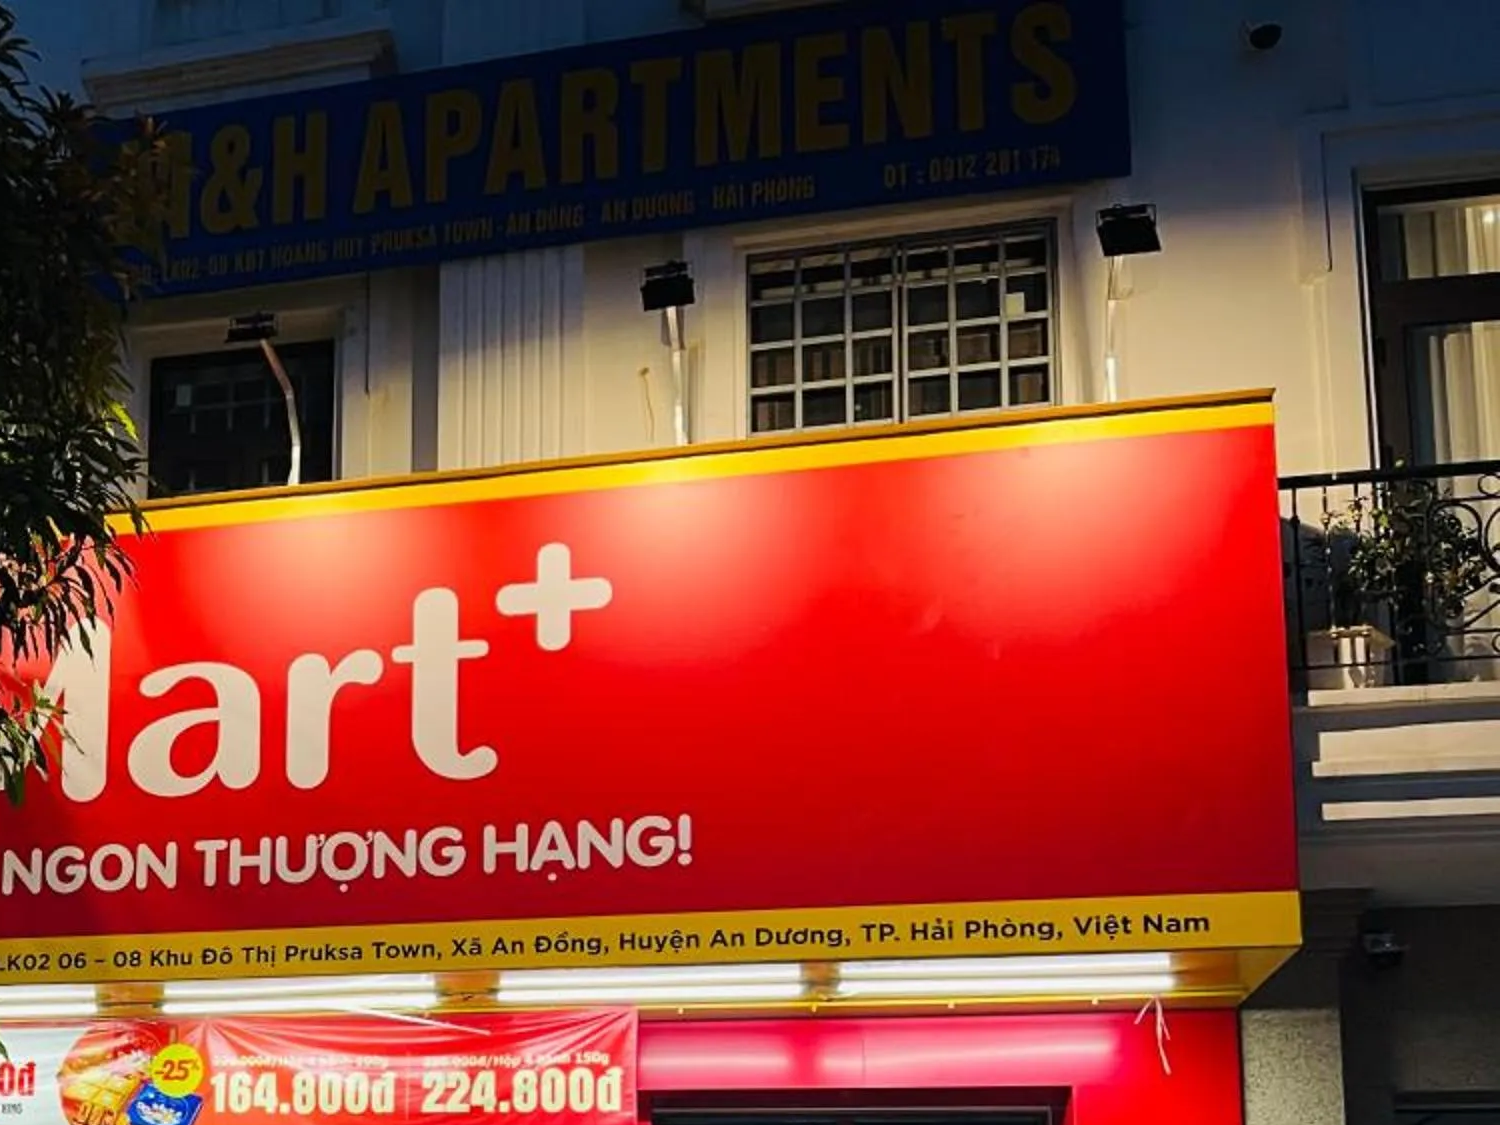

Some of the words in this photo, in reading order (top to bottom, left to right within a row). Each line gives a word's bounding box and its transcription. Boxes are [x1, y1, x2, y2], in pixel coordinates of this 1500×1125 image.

[353, 2, 1079, 214] APARTMENTS
[1, 841, 179, 896] NGON
[195, 826, 466, 893] THƯỢNG
[483, 813, 693, 882] HẠNG!
[57, 951, 87, 970] 06
[113, 950, 141, 969] 08
[150, 947, 194, 967] Khu
[201, 944, 234, 966] Đô
[241, 945, 276, 968] Thị
[285, 941, 363, 963] Pruksa
[372, 939, 442, 961] Town,
[451, 937, 484, 957] Xã
[492, 936, 525, 955] An
[619, 928, 700, 955] Huyện
[710, 929, 746, 948] An
[861, 923, 901, 943] TP.
[910, 917, 954, 941] Hải
[966, 916, 1064, 945] Phòng,
[1073, 913, 1132, 938] Việt
[1143, 914, 1211, 935] Nam
[211, 1070, 396, 1115] 164.800đ
[421, 1067, 622, 1113] 224.800đ
